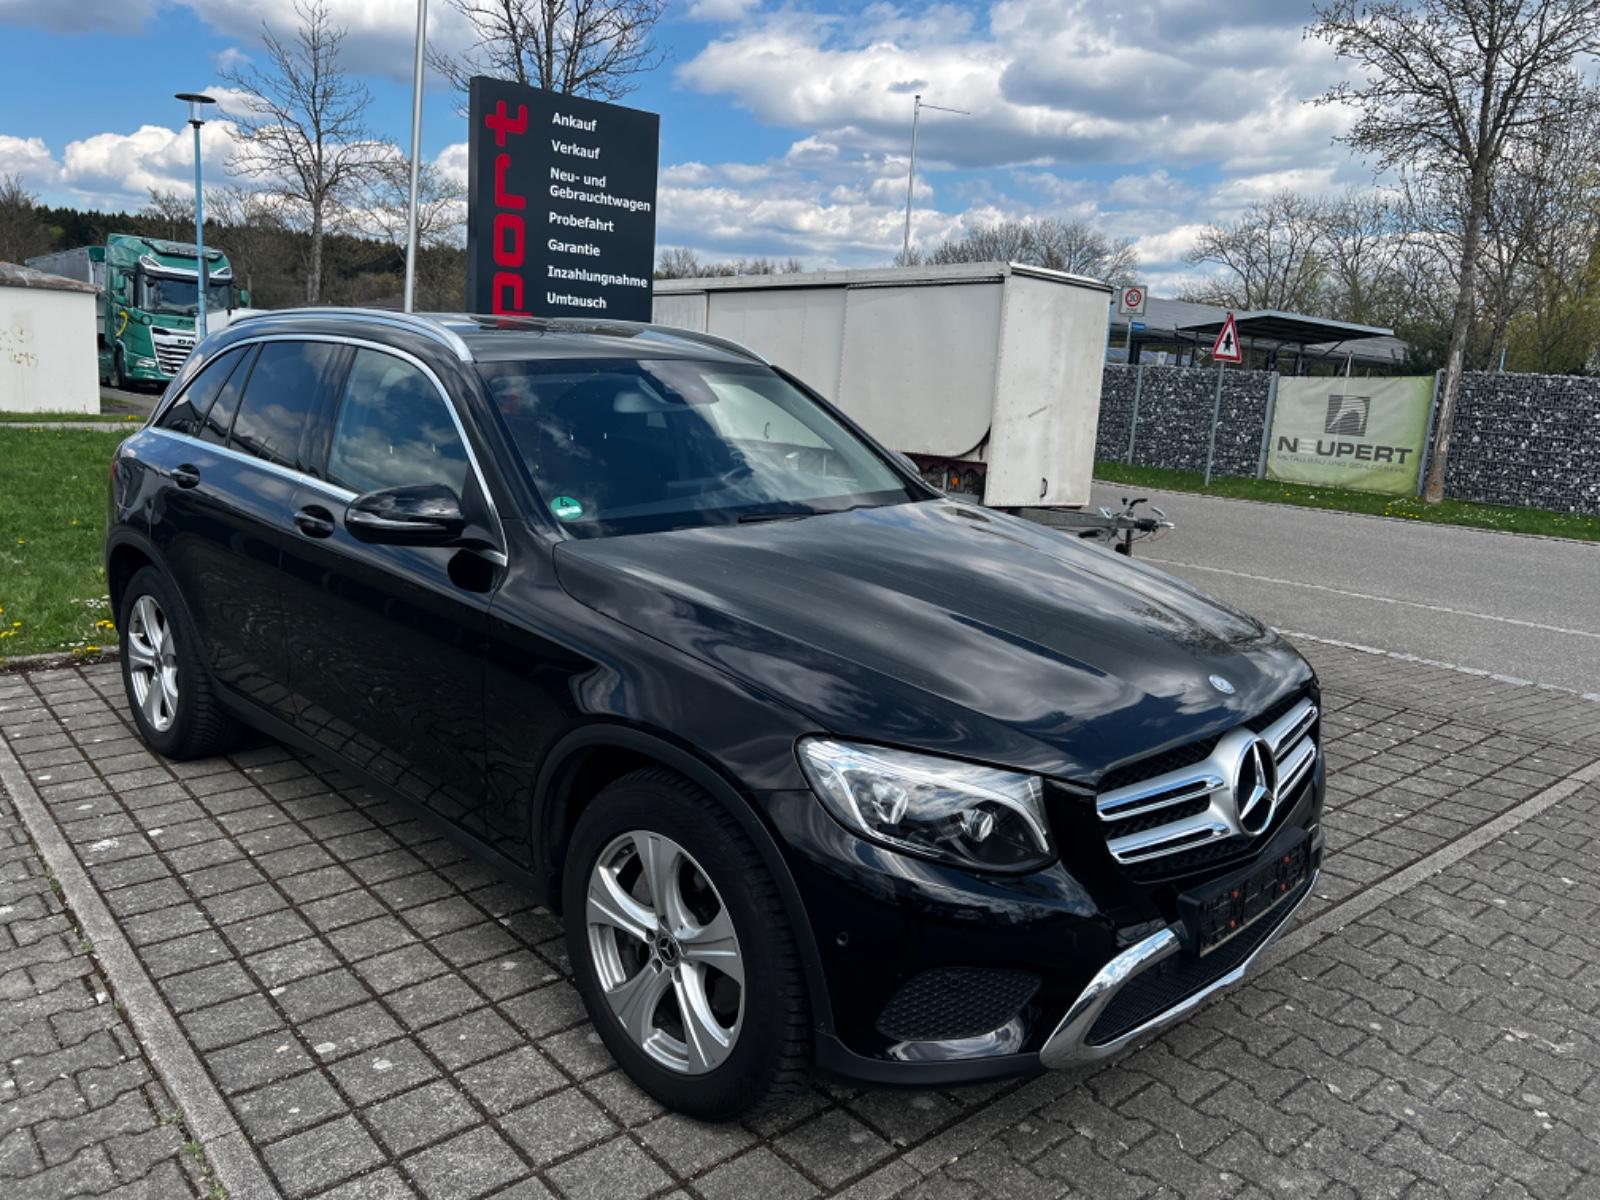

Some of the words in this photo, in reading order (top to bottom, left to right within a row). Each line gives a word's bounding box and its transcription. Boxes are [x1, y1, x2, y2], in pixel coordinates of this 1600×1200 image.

[552, 112, 597, 132] Ankauf
[551, 139, 600, 159] Verkauf
[550, 167, 580, 183] Neu-
[583, 174, 606, 188] und
[549, 185, 651, 212] Gebrauchtwagen
[548, 212, 615, 232] Probefahrt
[547, 239, 601, 256] Garantie
[547, 265, 648, 288] Inzahlungnahme
[547, 291, 607, 309] Umtausch
[1277, 436, 1413, 465] NEUPERT
